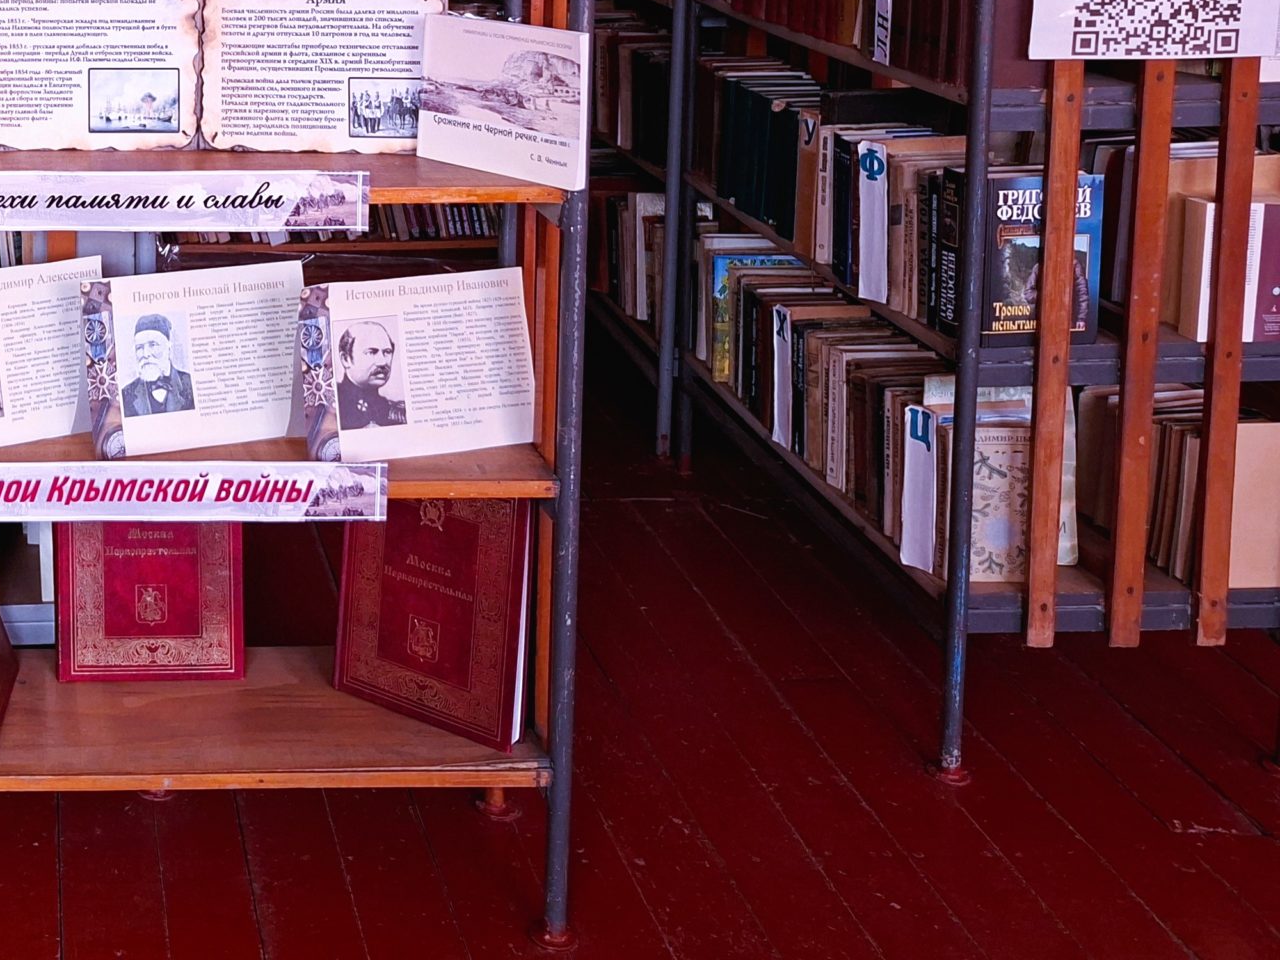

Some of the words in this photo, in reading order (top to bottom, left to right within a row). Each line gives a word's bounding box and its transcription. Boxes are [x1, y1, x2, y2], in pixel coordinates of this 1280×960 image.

[433, 115, 470, 130] Сражение
[473, 123, 482, 132] на
[484, 124, 512, 138] Черной
[860, 148, 884, 181] Ф
[45, 193, 168, 209] памяти
[177, 195, 196, 209] и
[206, 182, 285, 209] славы
[36, 267, 98, 286] Алексеевич
[345, 287, 394, 301] Истомин
[397, 281, 453, 299] Владимир
[456, 277, 509, 290] Иванович
[946, 252, 955, 320] ФЕДОСЕЕВ
[132, 288, 179, 305] Пирогов
[182, 281, 230, 298] Николай
[232, 278, 285, 292] Иванович
[993, 302, 1031, 319] Тропою
[909, 408, 931, 452] Ц
[47, 472, 208, 505] Крымской
[215, 473, 314, 503] войны
[128, 527, 173, 540] Москва
[406, 553, 452, 578] Москва
